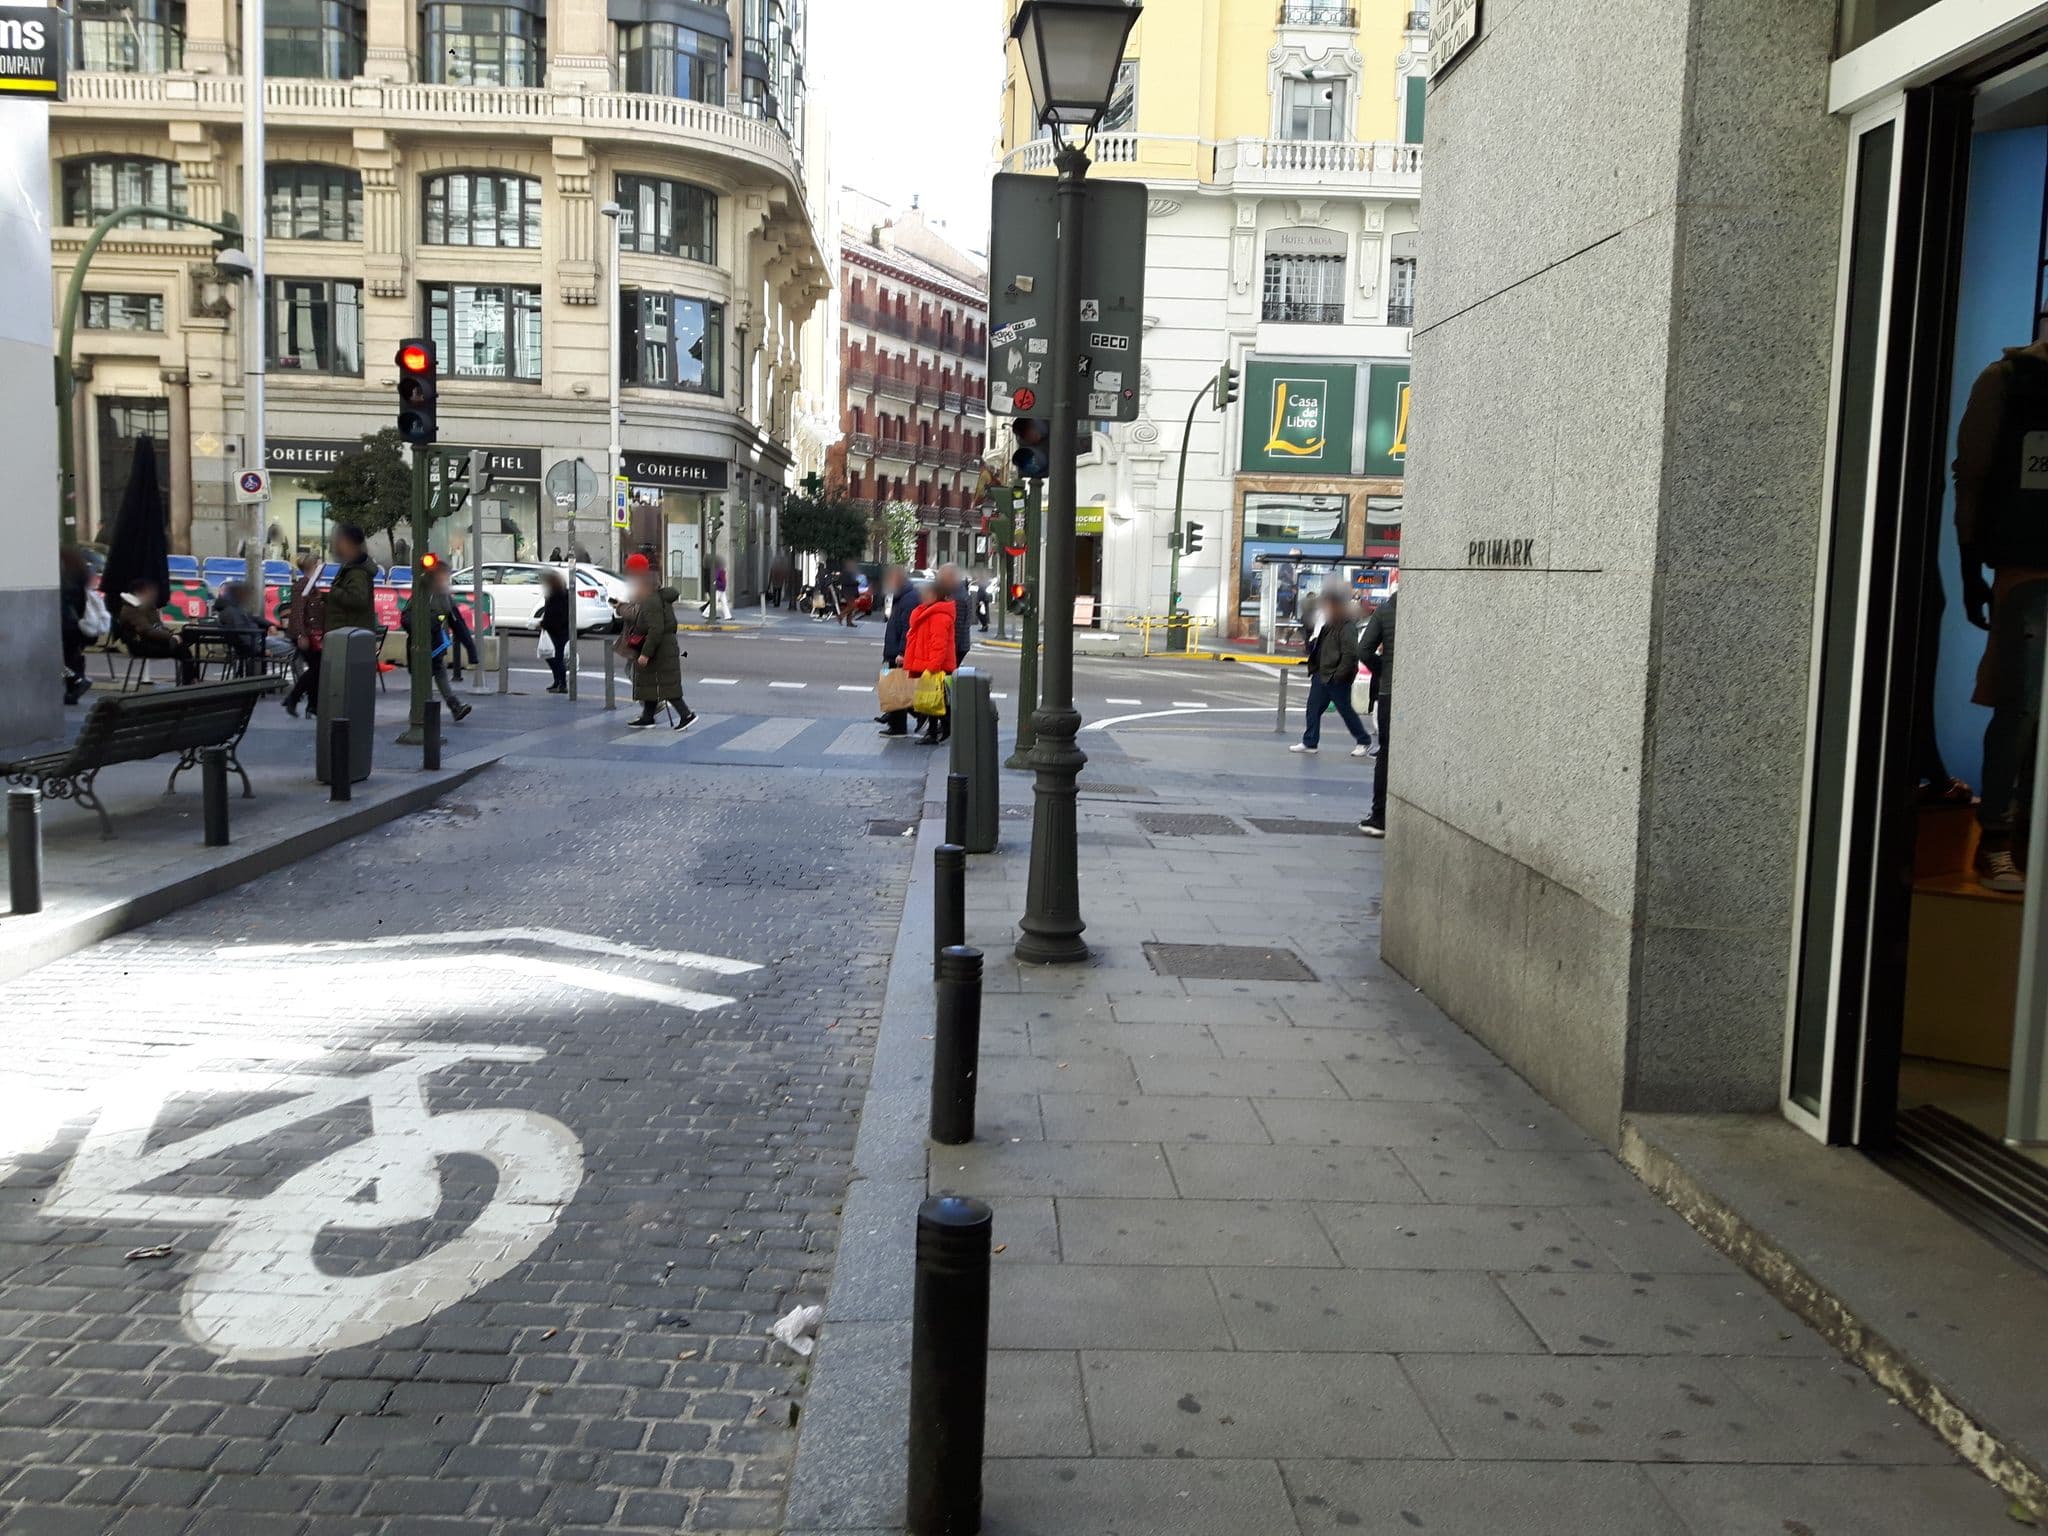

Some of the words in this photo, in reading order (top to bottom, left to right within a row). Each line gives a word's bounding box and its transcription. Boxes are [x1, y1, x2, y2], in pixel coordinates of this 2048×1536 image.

[1289, 395, 1318, 408] Casa
[1302, 407, 1318, 419] del
[1287, 415, 1317, 428] Libro
[264, 448, 344, 462] CORTEFIE
[637, 461, 709, 480] CORTEFIEL
[1468, 538, 1534, 567] PRIMARK
